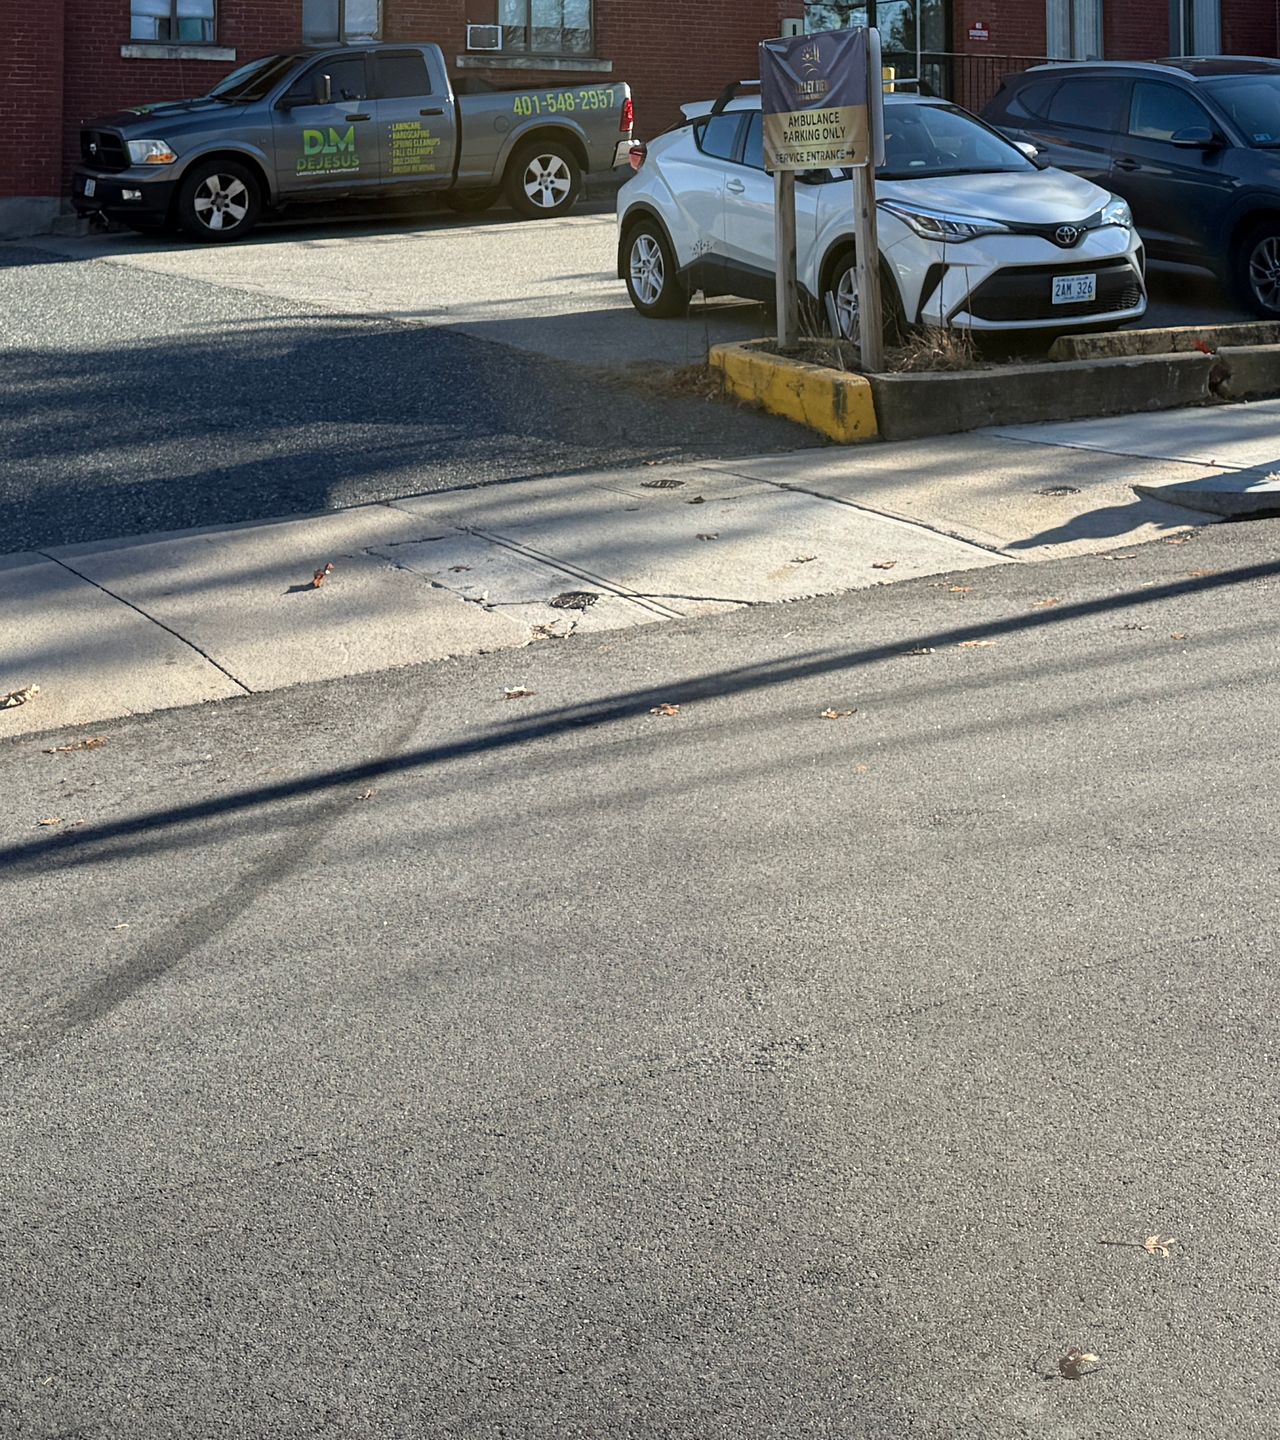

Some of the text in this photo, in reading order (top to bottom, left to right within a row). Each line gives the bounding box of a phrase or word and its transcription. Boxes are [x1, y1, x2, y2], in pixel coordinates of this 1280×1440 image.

[513, 89, 615, 116] 401-548-2957
[788, 112, 840, 128] AMBULANCE
[783, 126, 846, 142] PARKING ONLY
[296, 155, 360, 170] DEJESUS
[776, 149, 845, 163] SERVICE ENTRANCE
[1077, 281, 1093, 295] 326
